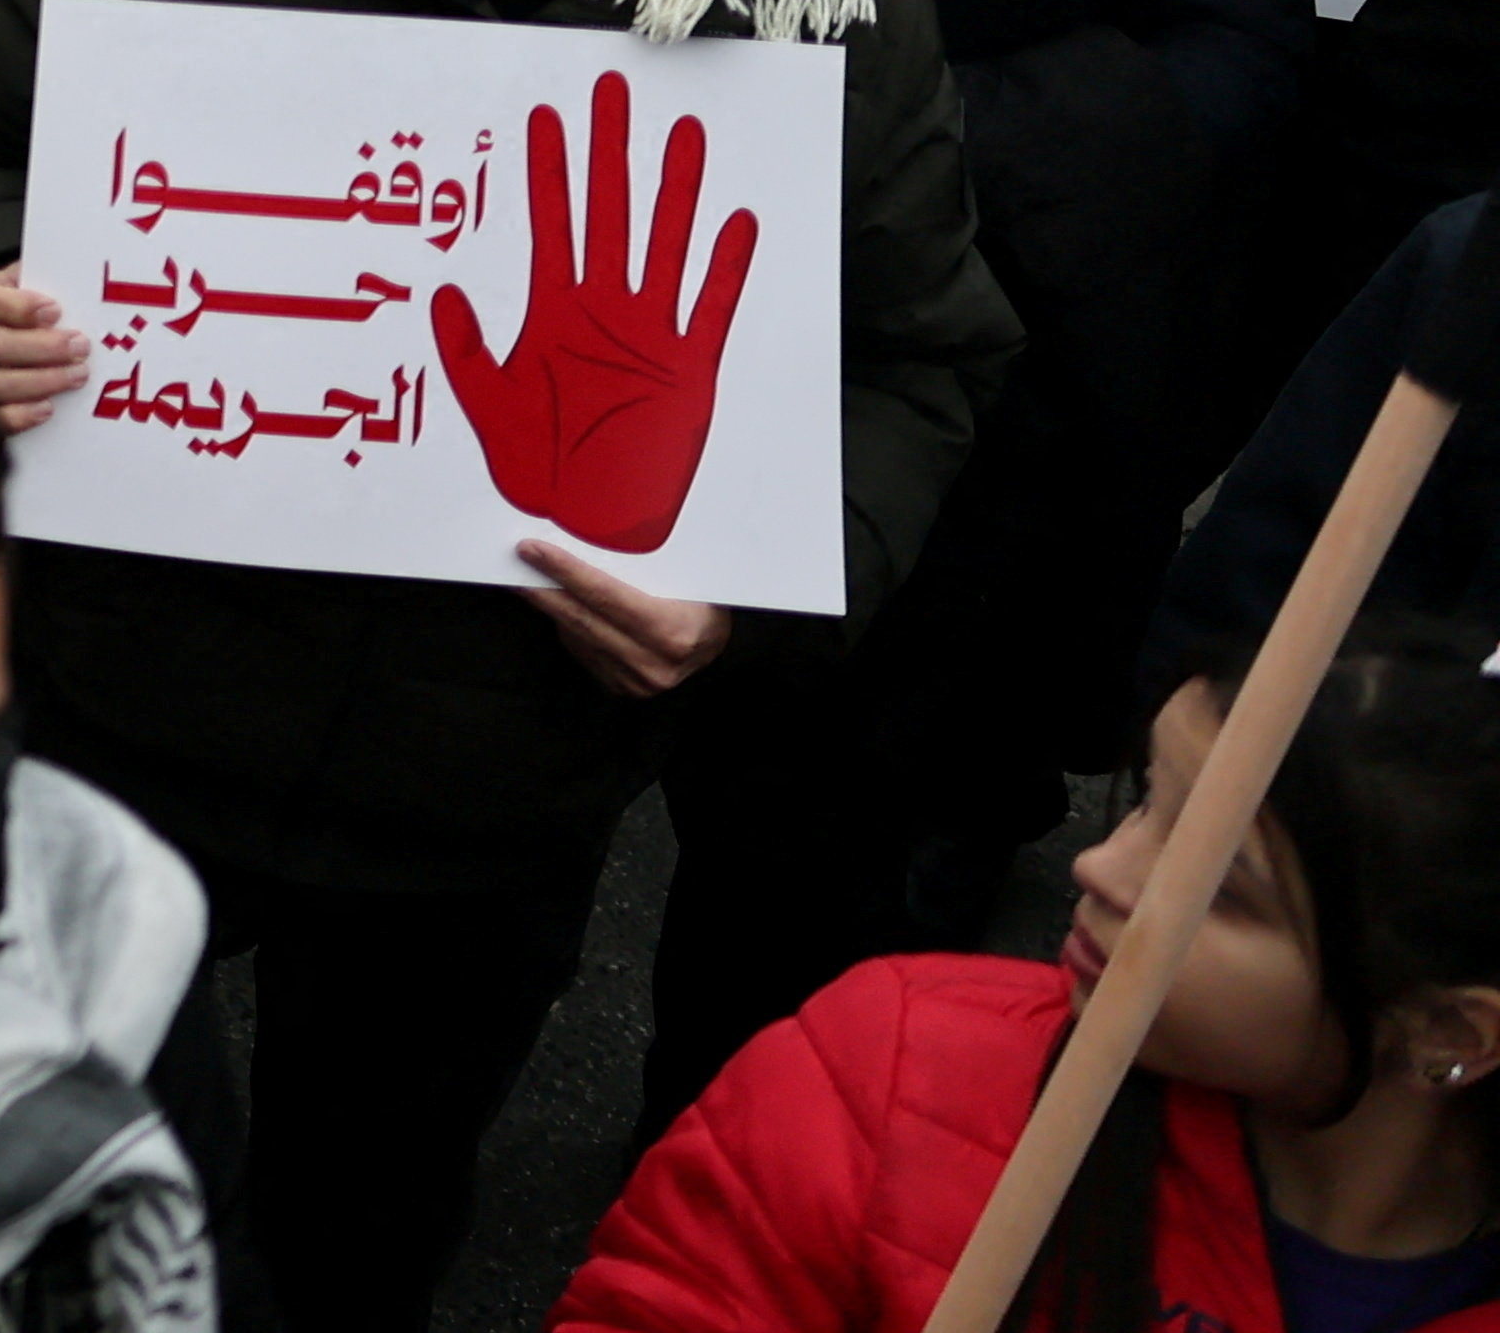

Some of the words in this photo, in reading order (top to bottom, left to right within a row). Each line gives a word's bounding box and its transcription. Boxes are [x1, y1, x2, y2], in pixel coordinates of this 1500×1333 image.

[110, 126, 495, 254] أوقفوا
[101, 254, 412, 338] حرب
[92, 331, 426, 469] الجريمة
